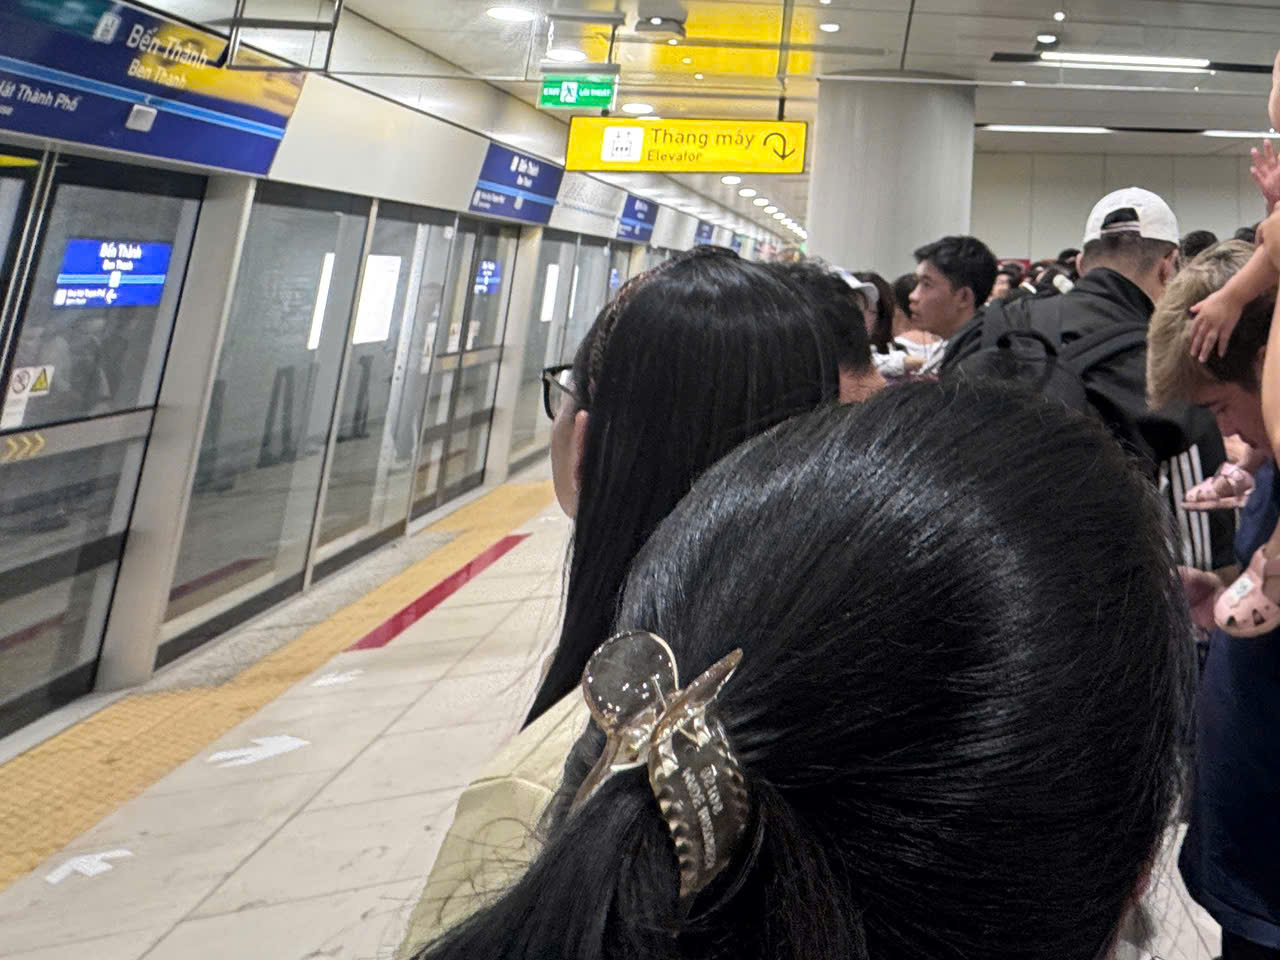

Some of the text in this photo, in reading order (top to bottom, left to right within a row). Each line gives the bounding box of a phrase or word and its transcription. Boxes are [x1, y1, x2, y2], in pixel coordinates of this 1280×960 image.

[126, 23, 209, 71] Bến Thành
[127, 58, 188, 89] Ben Thanh
[17, 83, 54, 107] Thành
[54, 92, 84, 112] Phố
[651, 127, 756, 148] Thang máy
[647, 150, 704, 162] Elevator
